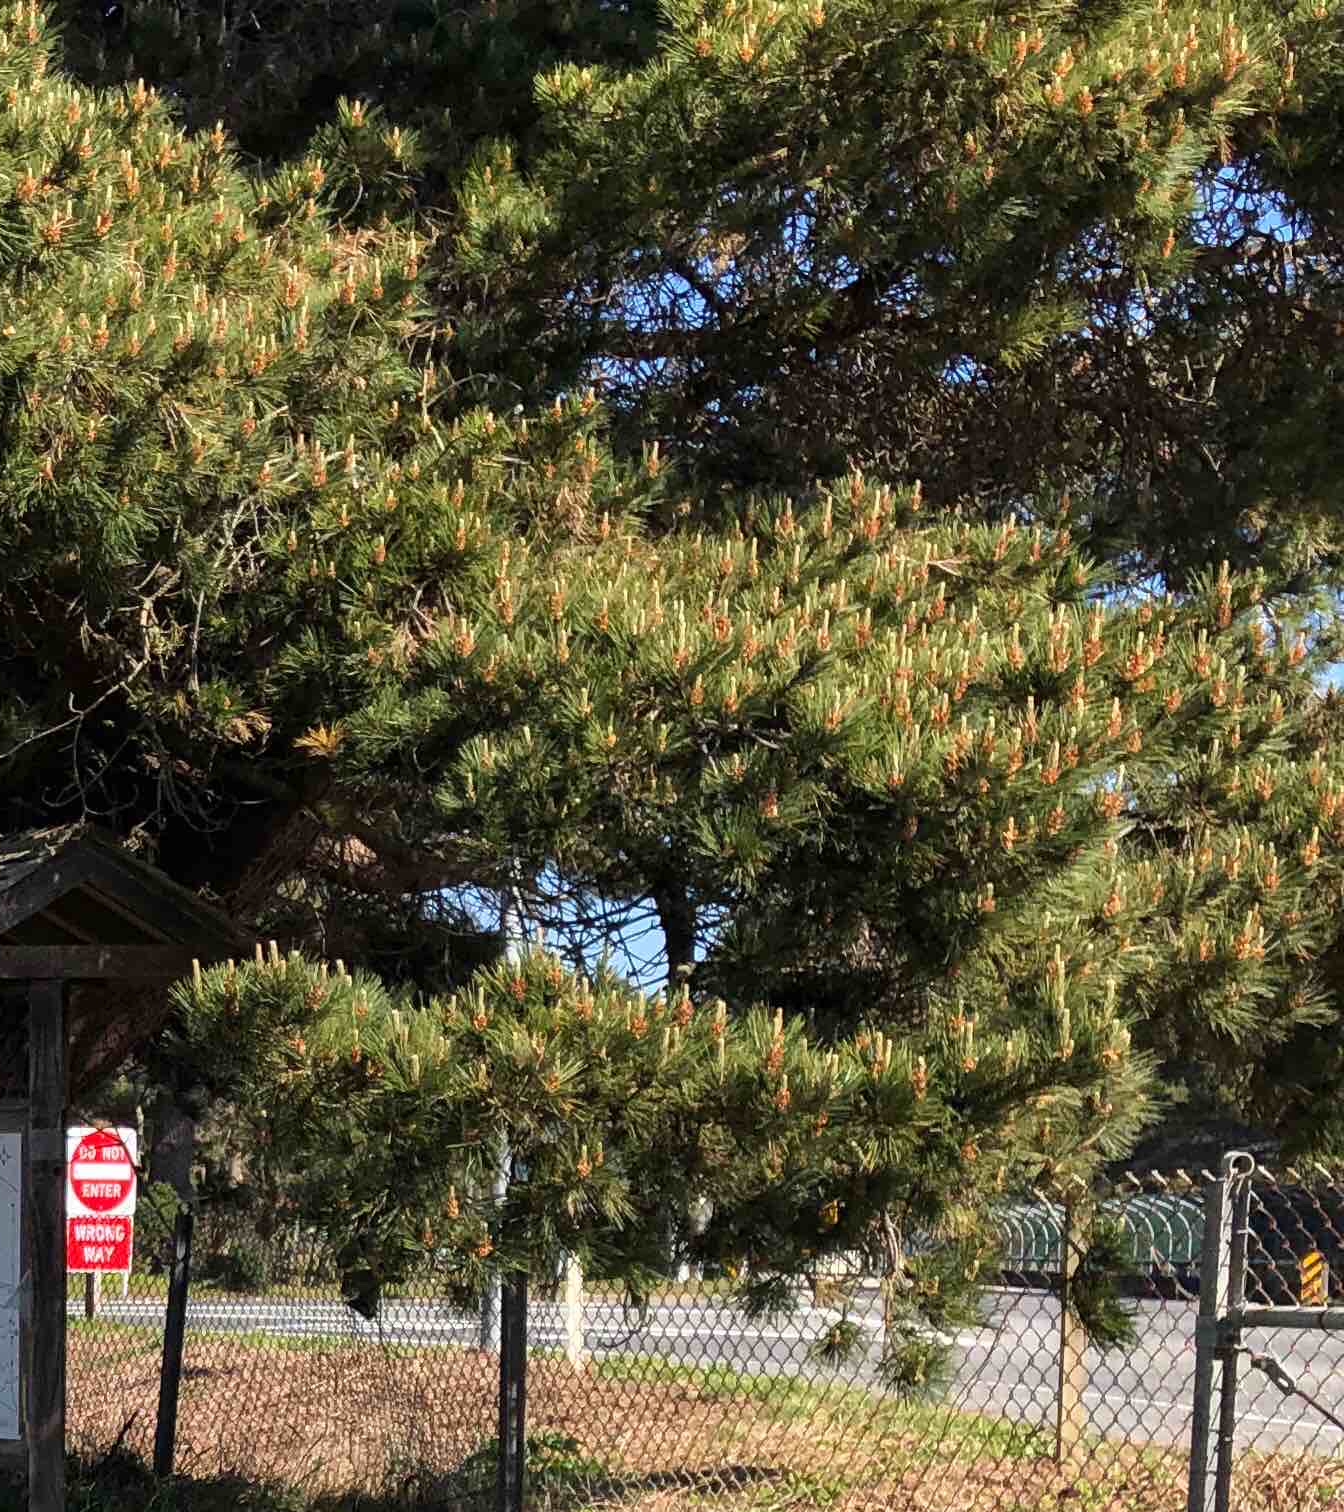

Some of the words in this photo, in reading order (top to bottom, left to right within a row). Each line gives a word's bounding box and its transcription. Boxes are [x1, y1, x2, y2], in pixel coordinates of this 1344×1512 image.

[79, 1146, 97, 1160] DO
[102, 1146, 126, 1161] NOT
[81, 1184, 122, 1199] ENTER
[74, 1226, 125, 1242] WRONG
[82, 1247, 115, 1263] WAY
